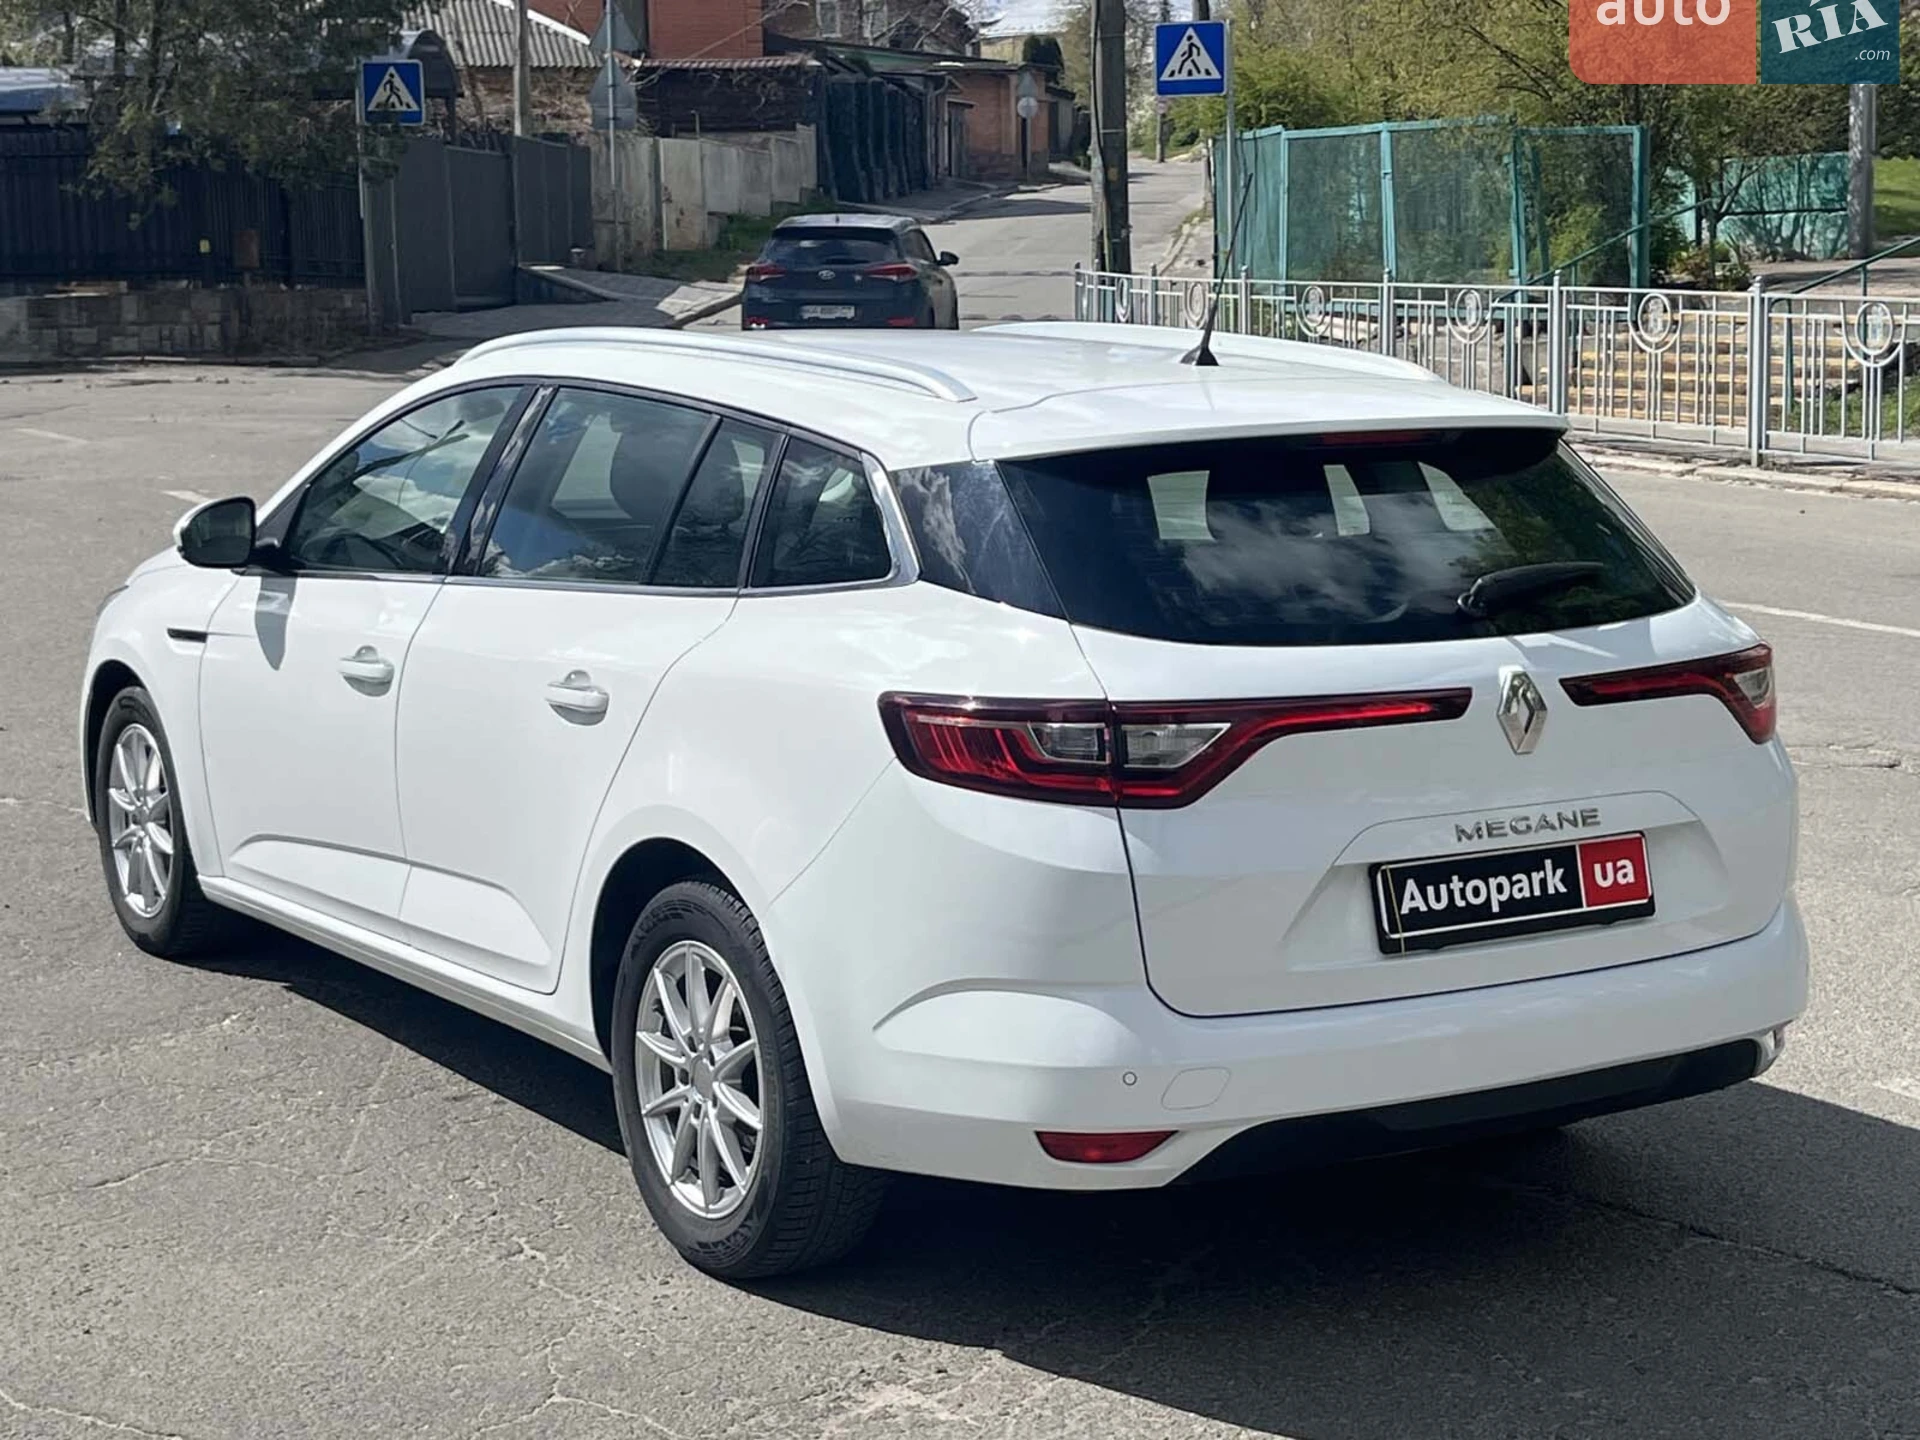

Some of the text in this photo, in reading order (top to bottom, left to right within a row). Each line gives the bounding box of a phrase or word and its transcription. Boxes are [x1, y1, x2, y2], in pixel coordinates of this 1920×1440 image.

[1455, 808, 1602, 843] MEGANE
[1400, 857, 1636, 915] Autopark ua
